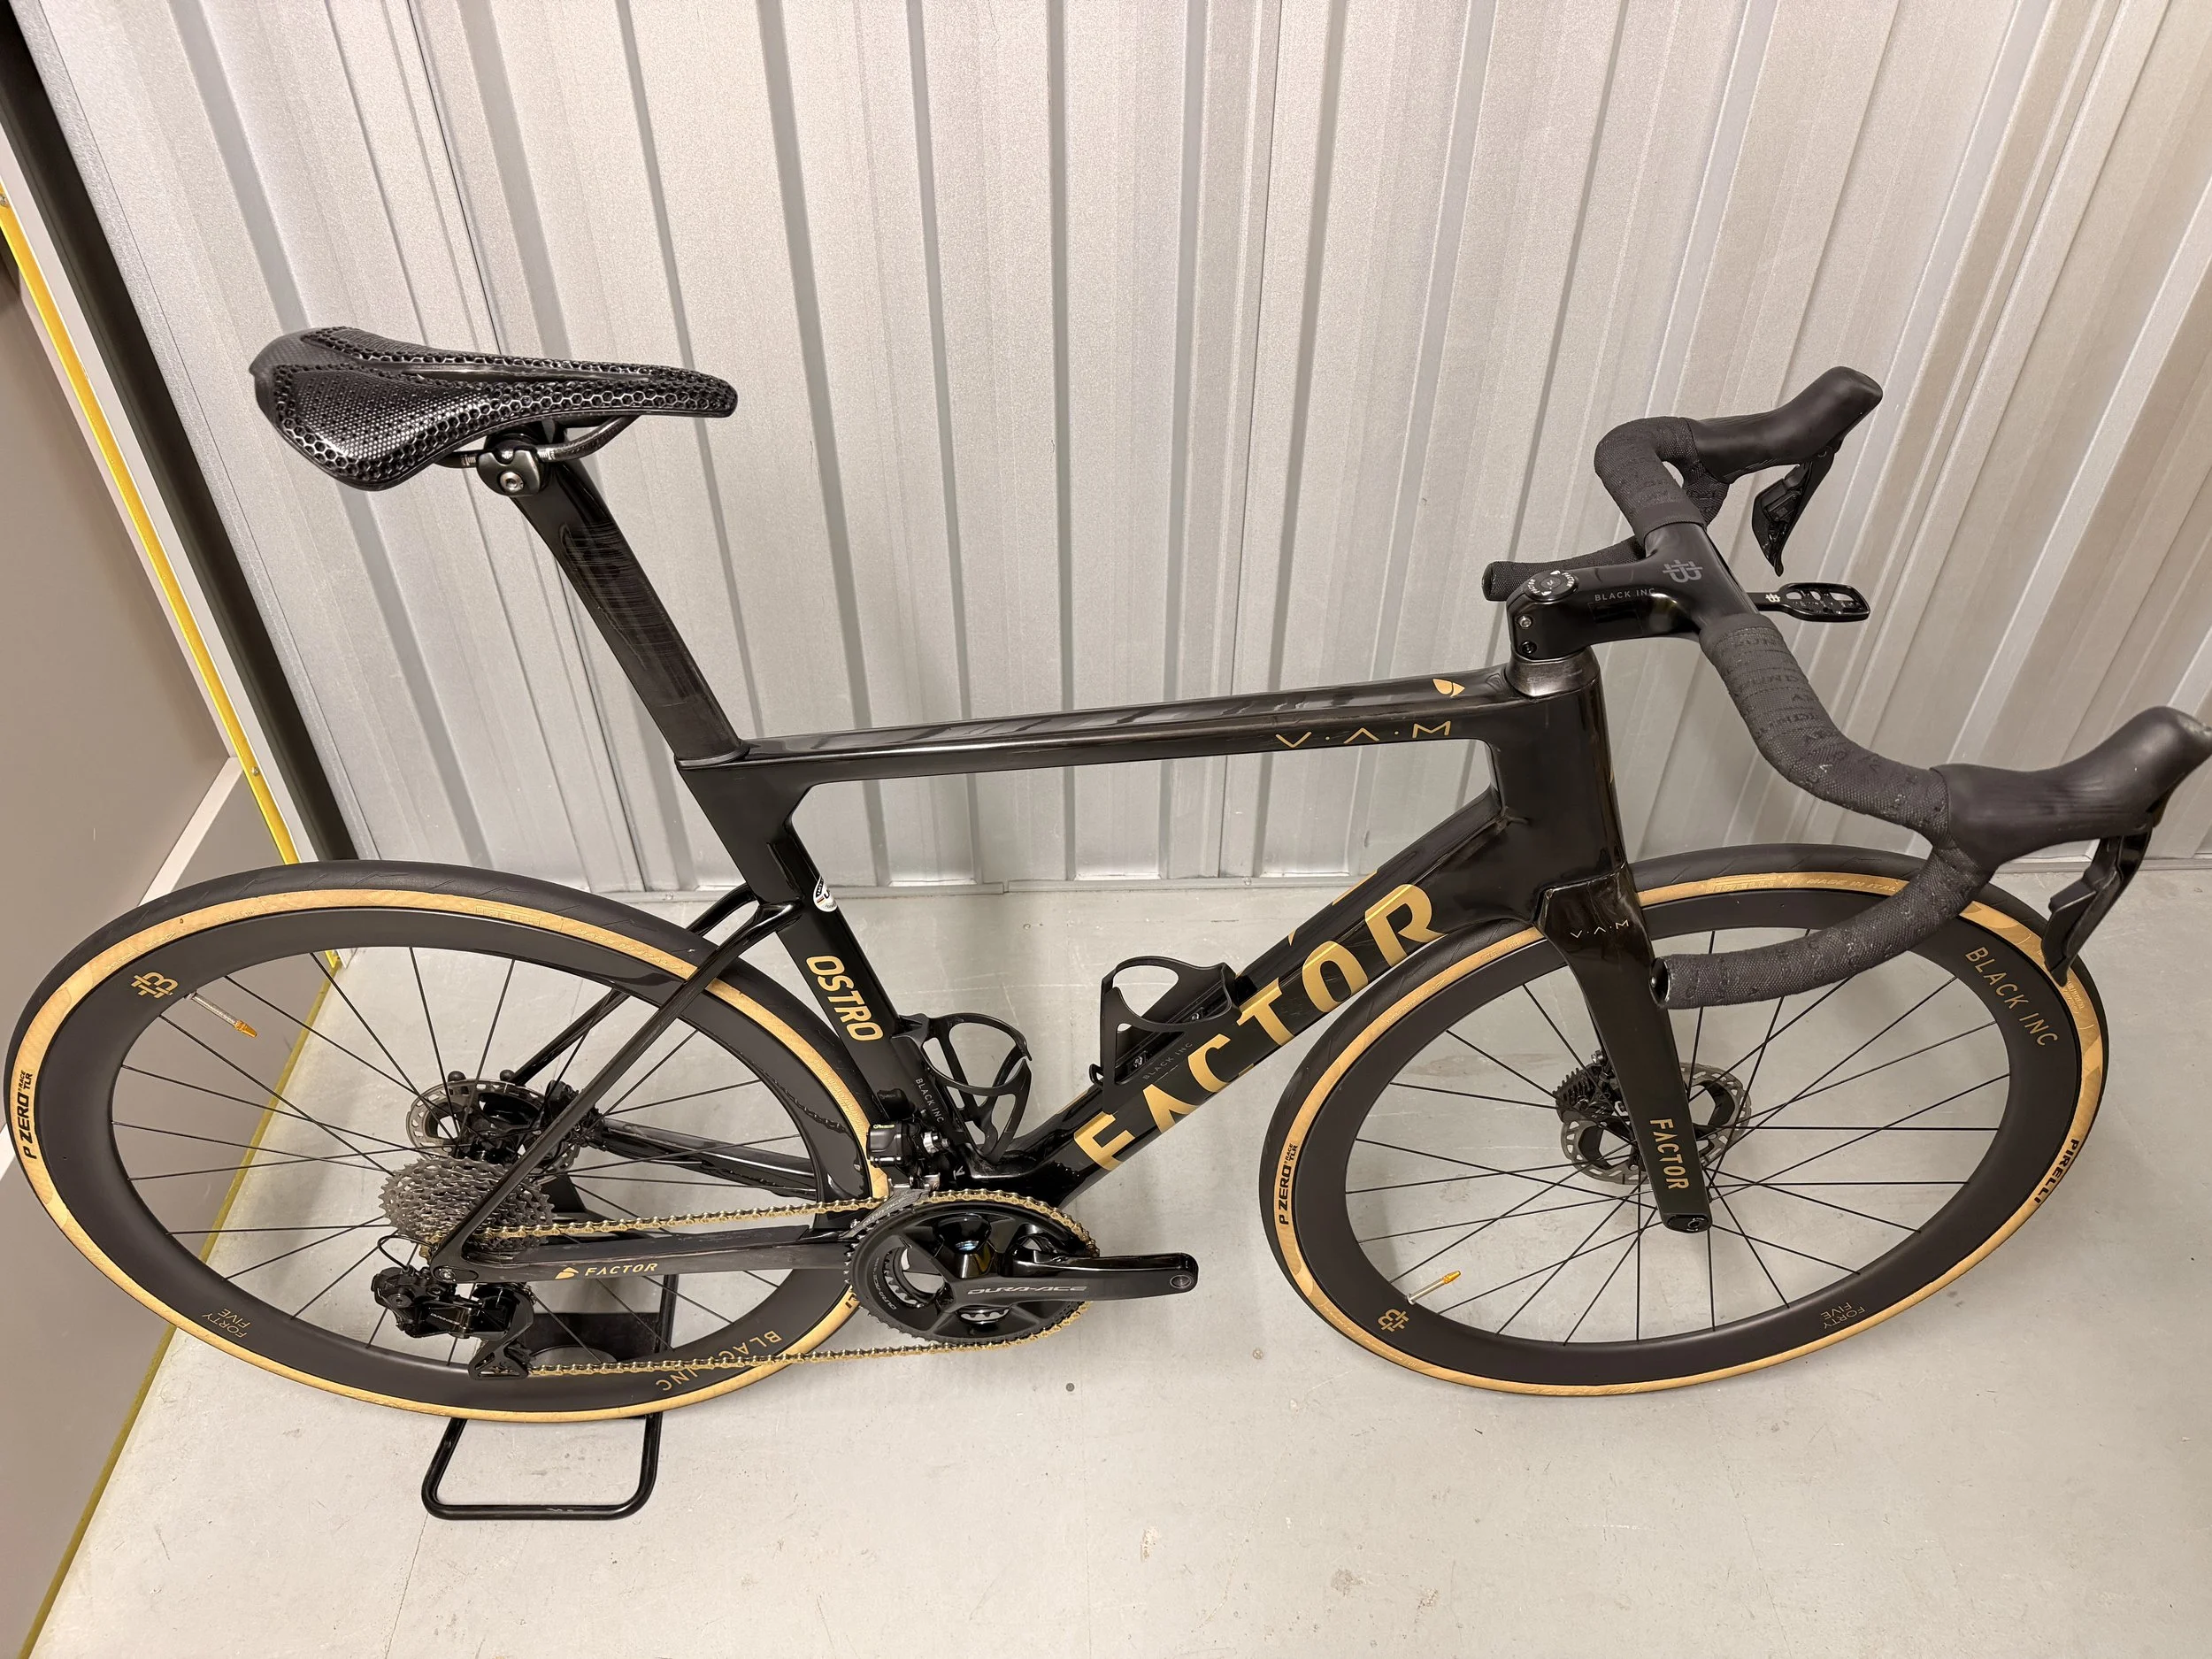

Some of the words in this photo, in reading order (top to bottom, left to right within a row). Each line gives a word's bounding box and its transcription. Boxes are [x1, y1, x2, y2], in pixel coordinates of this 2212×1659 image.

[1594, 590, 1632, 602] BLACK
[1636, 588, 1655, 597] INC
[806, 955, 884, 1042] OSTRO
[1965, 946, 2029, 1010] BLACK
[2019, 1012, 2058, 1046] INC
[1073, 883, 1447, 1171] FACTOR
[1142, 1056, 1174, 1079] BLACK
[1174, 1042, 1193, 1056] INC
[18, 1069, 27, 1088] RACE
[23, 1072, 34, 1091] TLR
[915, 1078, 935, 1106] BLACK
[931, 1107, 944, 1123] INC
[17, 1091, 34, 1144] ZERO
[24, 1148, 37, 1160] P
[1289, 1145, 1298, 1162] TLR
[1649, 1118, 1690, 1189] FACTOR
[2033, 1139, 2079, 1203] PIRELLI
[1279, 1164, 1292, 1211] ZERO
[1279, 1214, 1289, 1225] P
[584, 1263, 658, 1277] FACTOR
[967, 1286, 1087, 1295] DURA-ACE
[218, 1308, 250, 1329] FIVE
[1820, 1302, 1853, 1320] FIVE
[1823, 1306, 1866, 1329] FORTY
[202, 1313, 248, 1338] FORTY
[709, 1330, 783, 1369] BLAC
